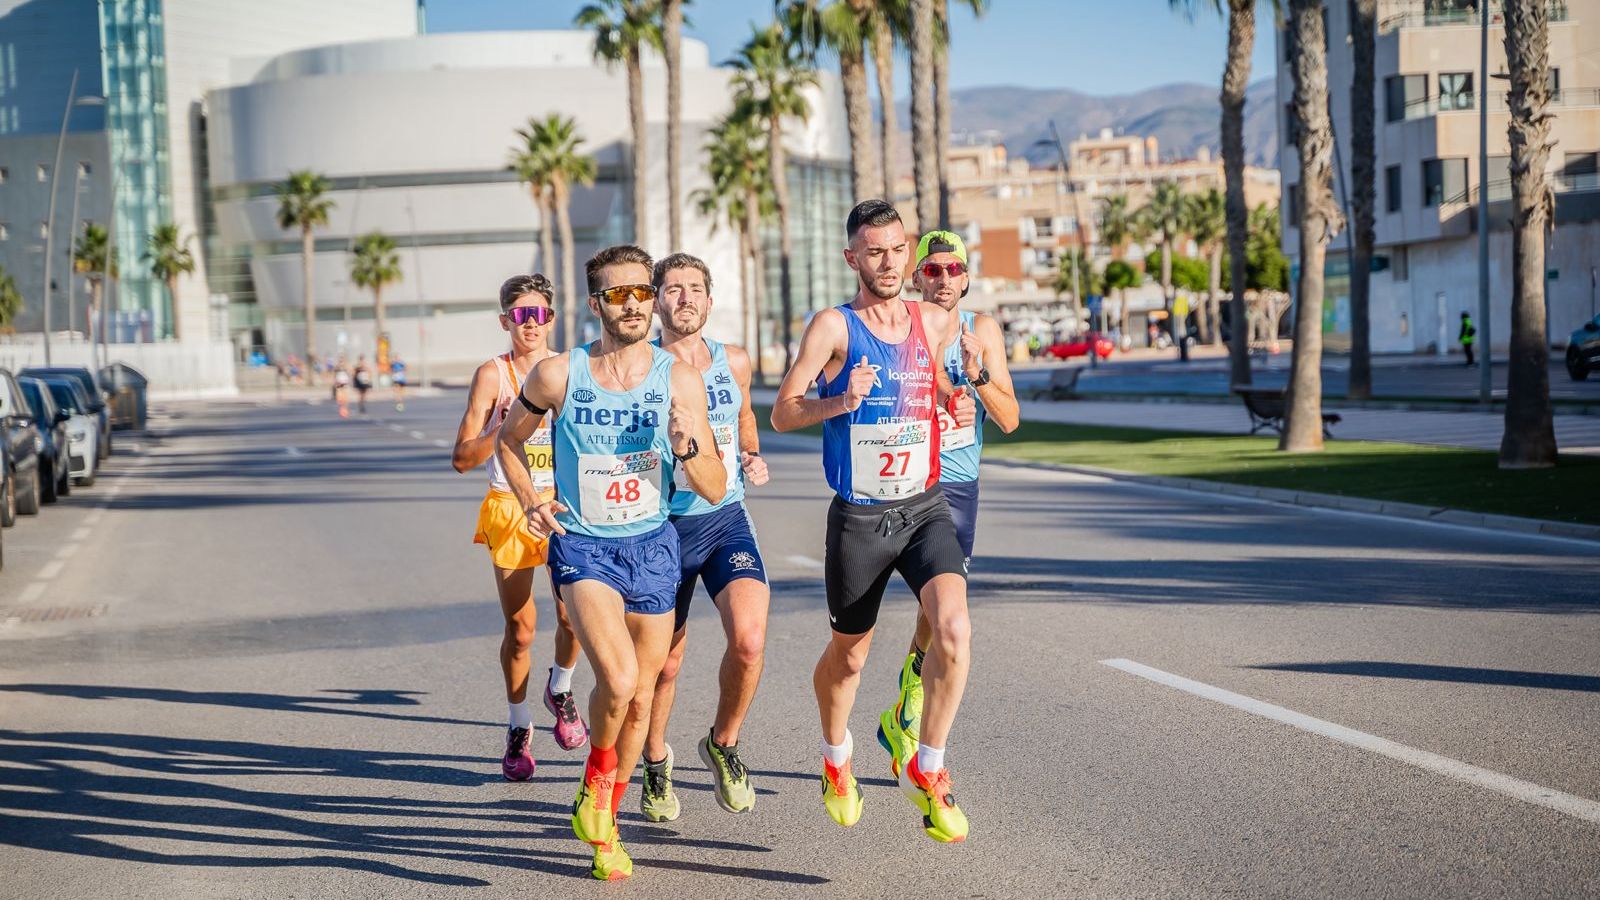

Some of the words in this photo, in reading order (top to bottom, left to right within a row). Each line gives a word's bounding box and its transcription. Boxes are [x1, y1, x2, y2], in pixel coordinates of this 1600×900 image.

[888, 368, 934, 385] lapalma
[573, 390, 596, 402] TROPS
[706, 384, 734, 411] ja
[573, 402, 660, 433] nerja
[876, 415, 918, 425] ATLETISMO
[585, 434, 649, 447] ATLETISMO
[879, 451, 911, 477] 27
[605, 478, 641, 504] 48
